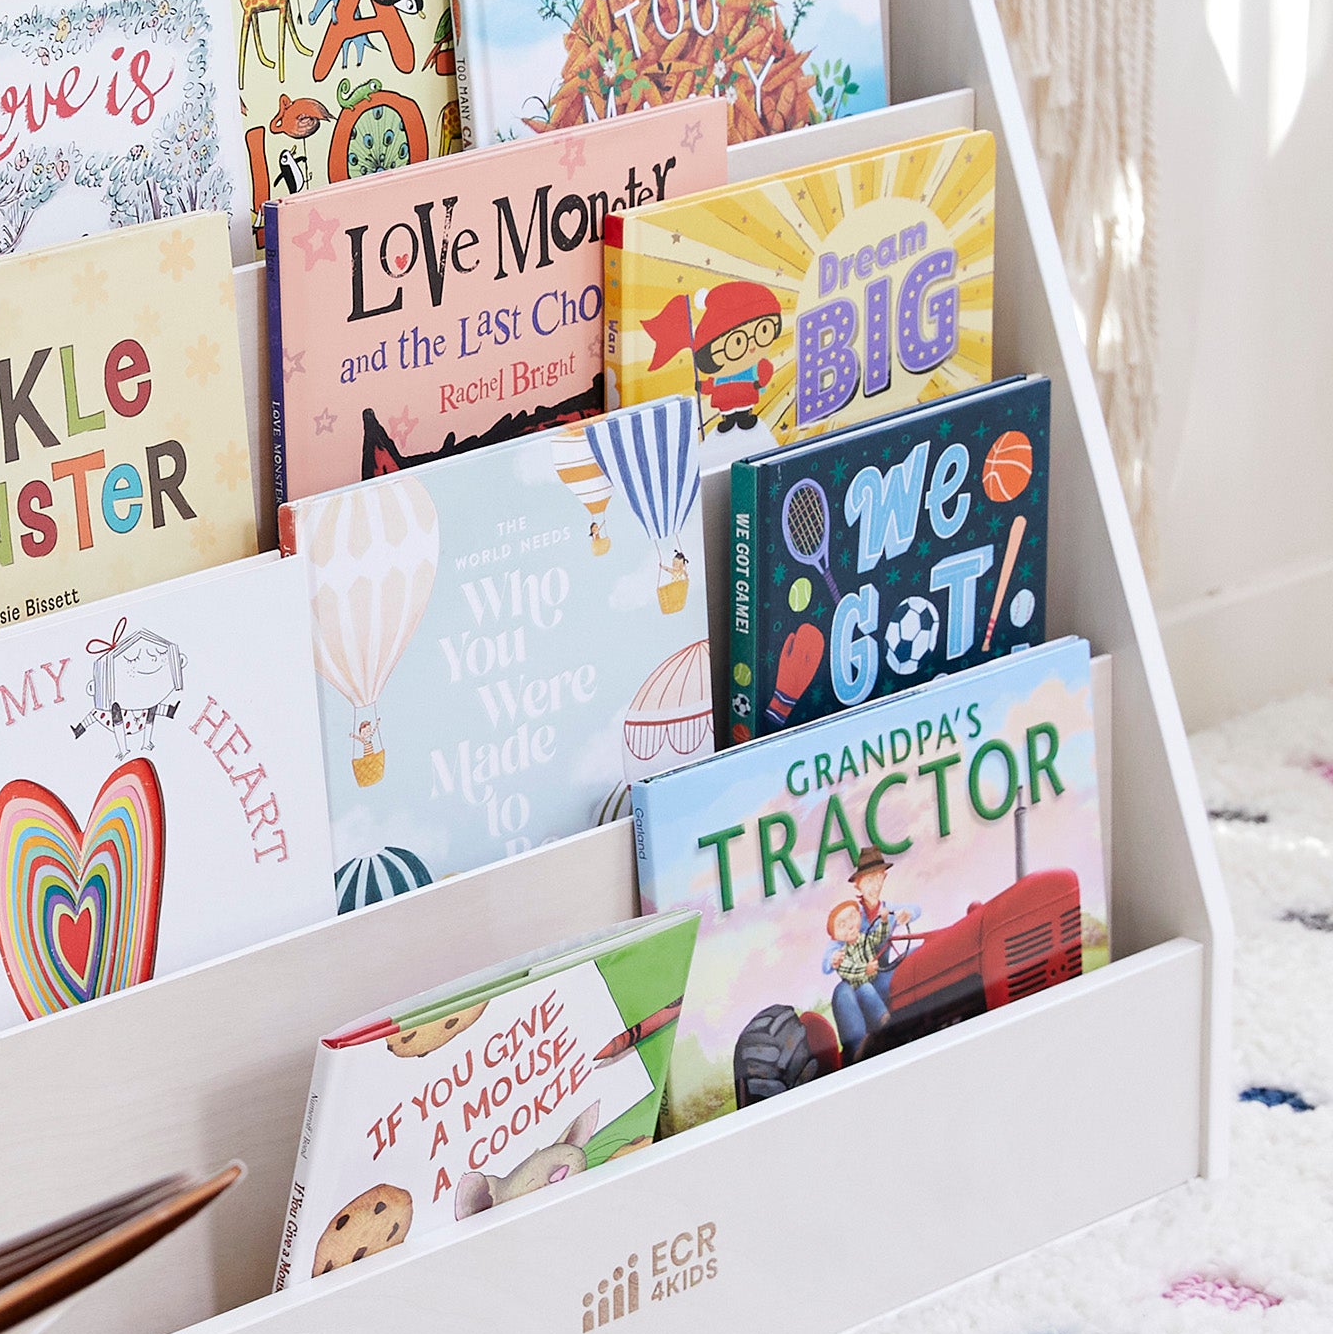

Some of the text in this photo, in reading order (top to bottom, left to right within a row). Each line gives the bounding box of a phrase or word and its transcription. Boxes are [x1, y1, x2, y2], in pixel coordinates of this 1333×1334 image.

[104, 46, 176, 127] is
[456, 57, 467, 82] TOO
[459, 87, 471, 121] MANY
[818, 220, 928, 298] Dream
[339, 338, 387, 385] and
[396, 327, 447, 371] the
[457, 302, 523, 360] Last
[606, 319, 621, 355] Wan
[795, 247, 959, 430] BIG
[438, 351, 577, 414] Rachel Bright
[271, 400, 284, 504] LOVE MONSTER
[454, 525, 572, 571] WORLD NEEDS
[496, 516, 528, 538] THE
[24, 587, 81, 619] Bissett
[460, 566, 571, 629] Who
[733, 512, 751, 635] WE GOT GAME!
[437, 624, 527, 685] You
[476, 662, 598, 730] Were
[188, 695, 290, 865] HEART
[428, 722, 559, 805] Made
[786, 701, 983, 797] GRANDPA'S
[483, 791, 530, 838] to
[634, 806, 647, 860] Garland
[696, 720, 1066, 914] TRACTOR
[367, 988, 565, 1161] IF YOU GIVE
[430, 1025, 579, 1161] A MOUSE
[432, 1052, 598, 1203] A COOKIE
[289, 1195, 303, 1219] You
[294, 1180, 306, 1197] If
[282, 1248, 290, 1258] a
[283, 1219, 299, 1249] Give
[651, 1221, 717, 1277] ECR
[650, 1257, 719, 1302] 4KIDS
